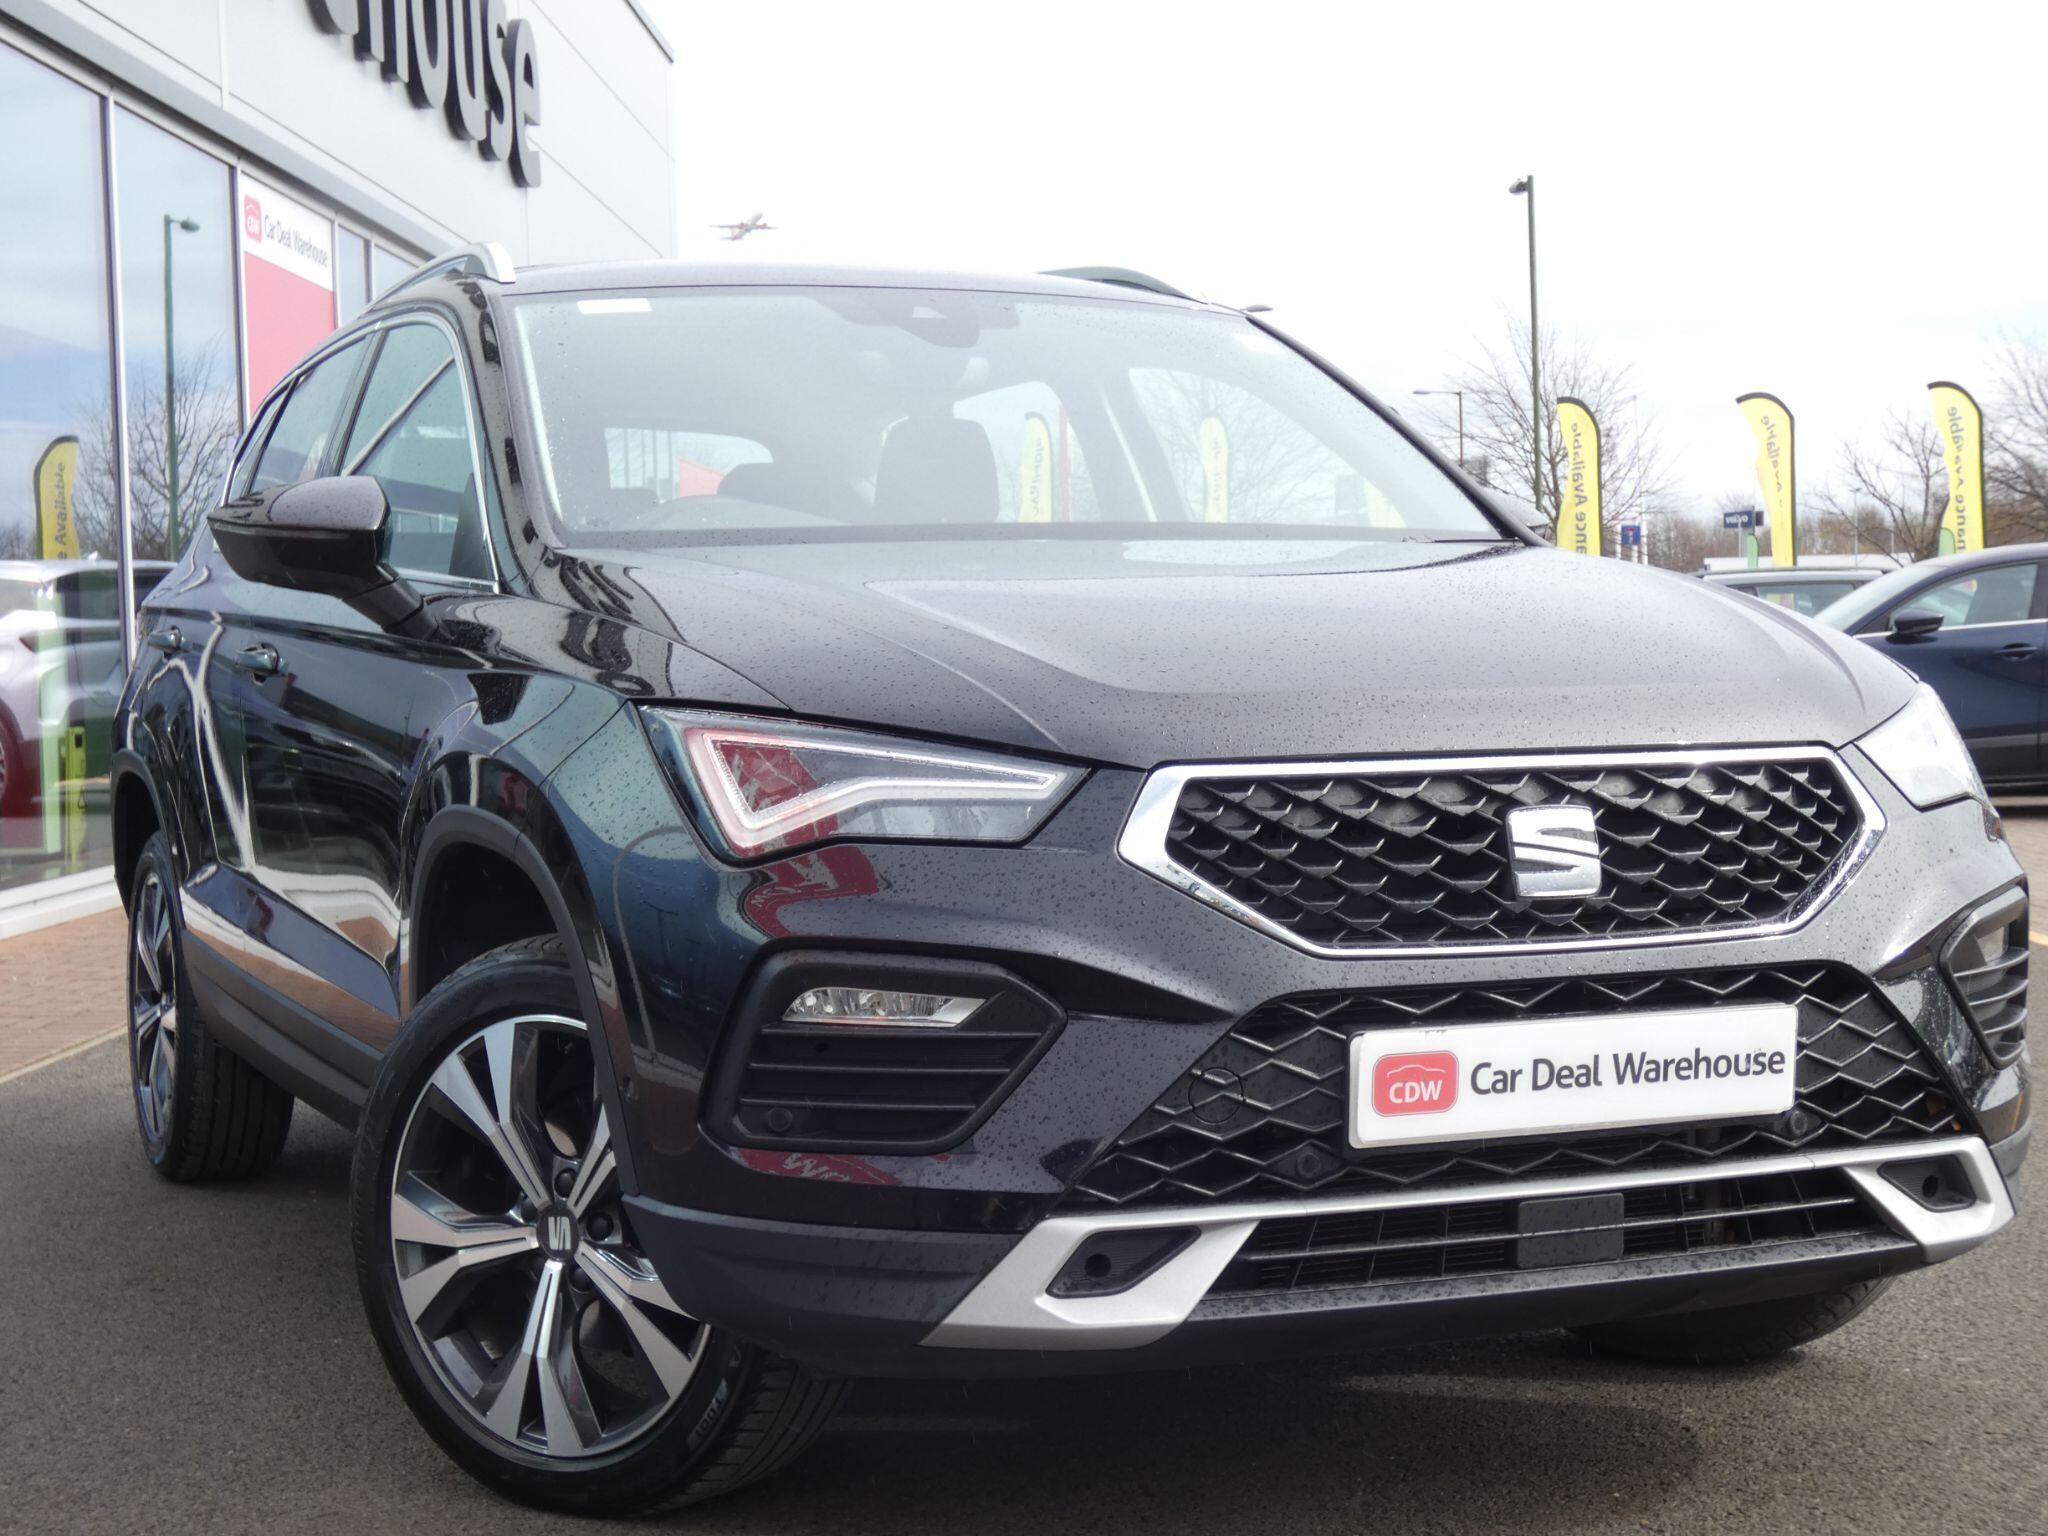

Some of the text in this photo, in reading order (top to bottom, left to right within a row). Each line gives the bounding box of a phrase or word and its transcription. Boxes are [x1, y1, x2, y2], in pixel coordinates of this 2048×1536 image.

[264, 214, 328, 268] Car Deal Warehouse
[54, 461, 67, 546] Available
[1389, 1080, 1443, 1104] CDW
[1470, 1048, 1786, 1096] Car Deal Warehouse
